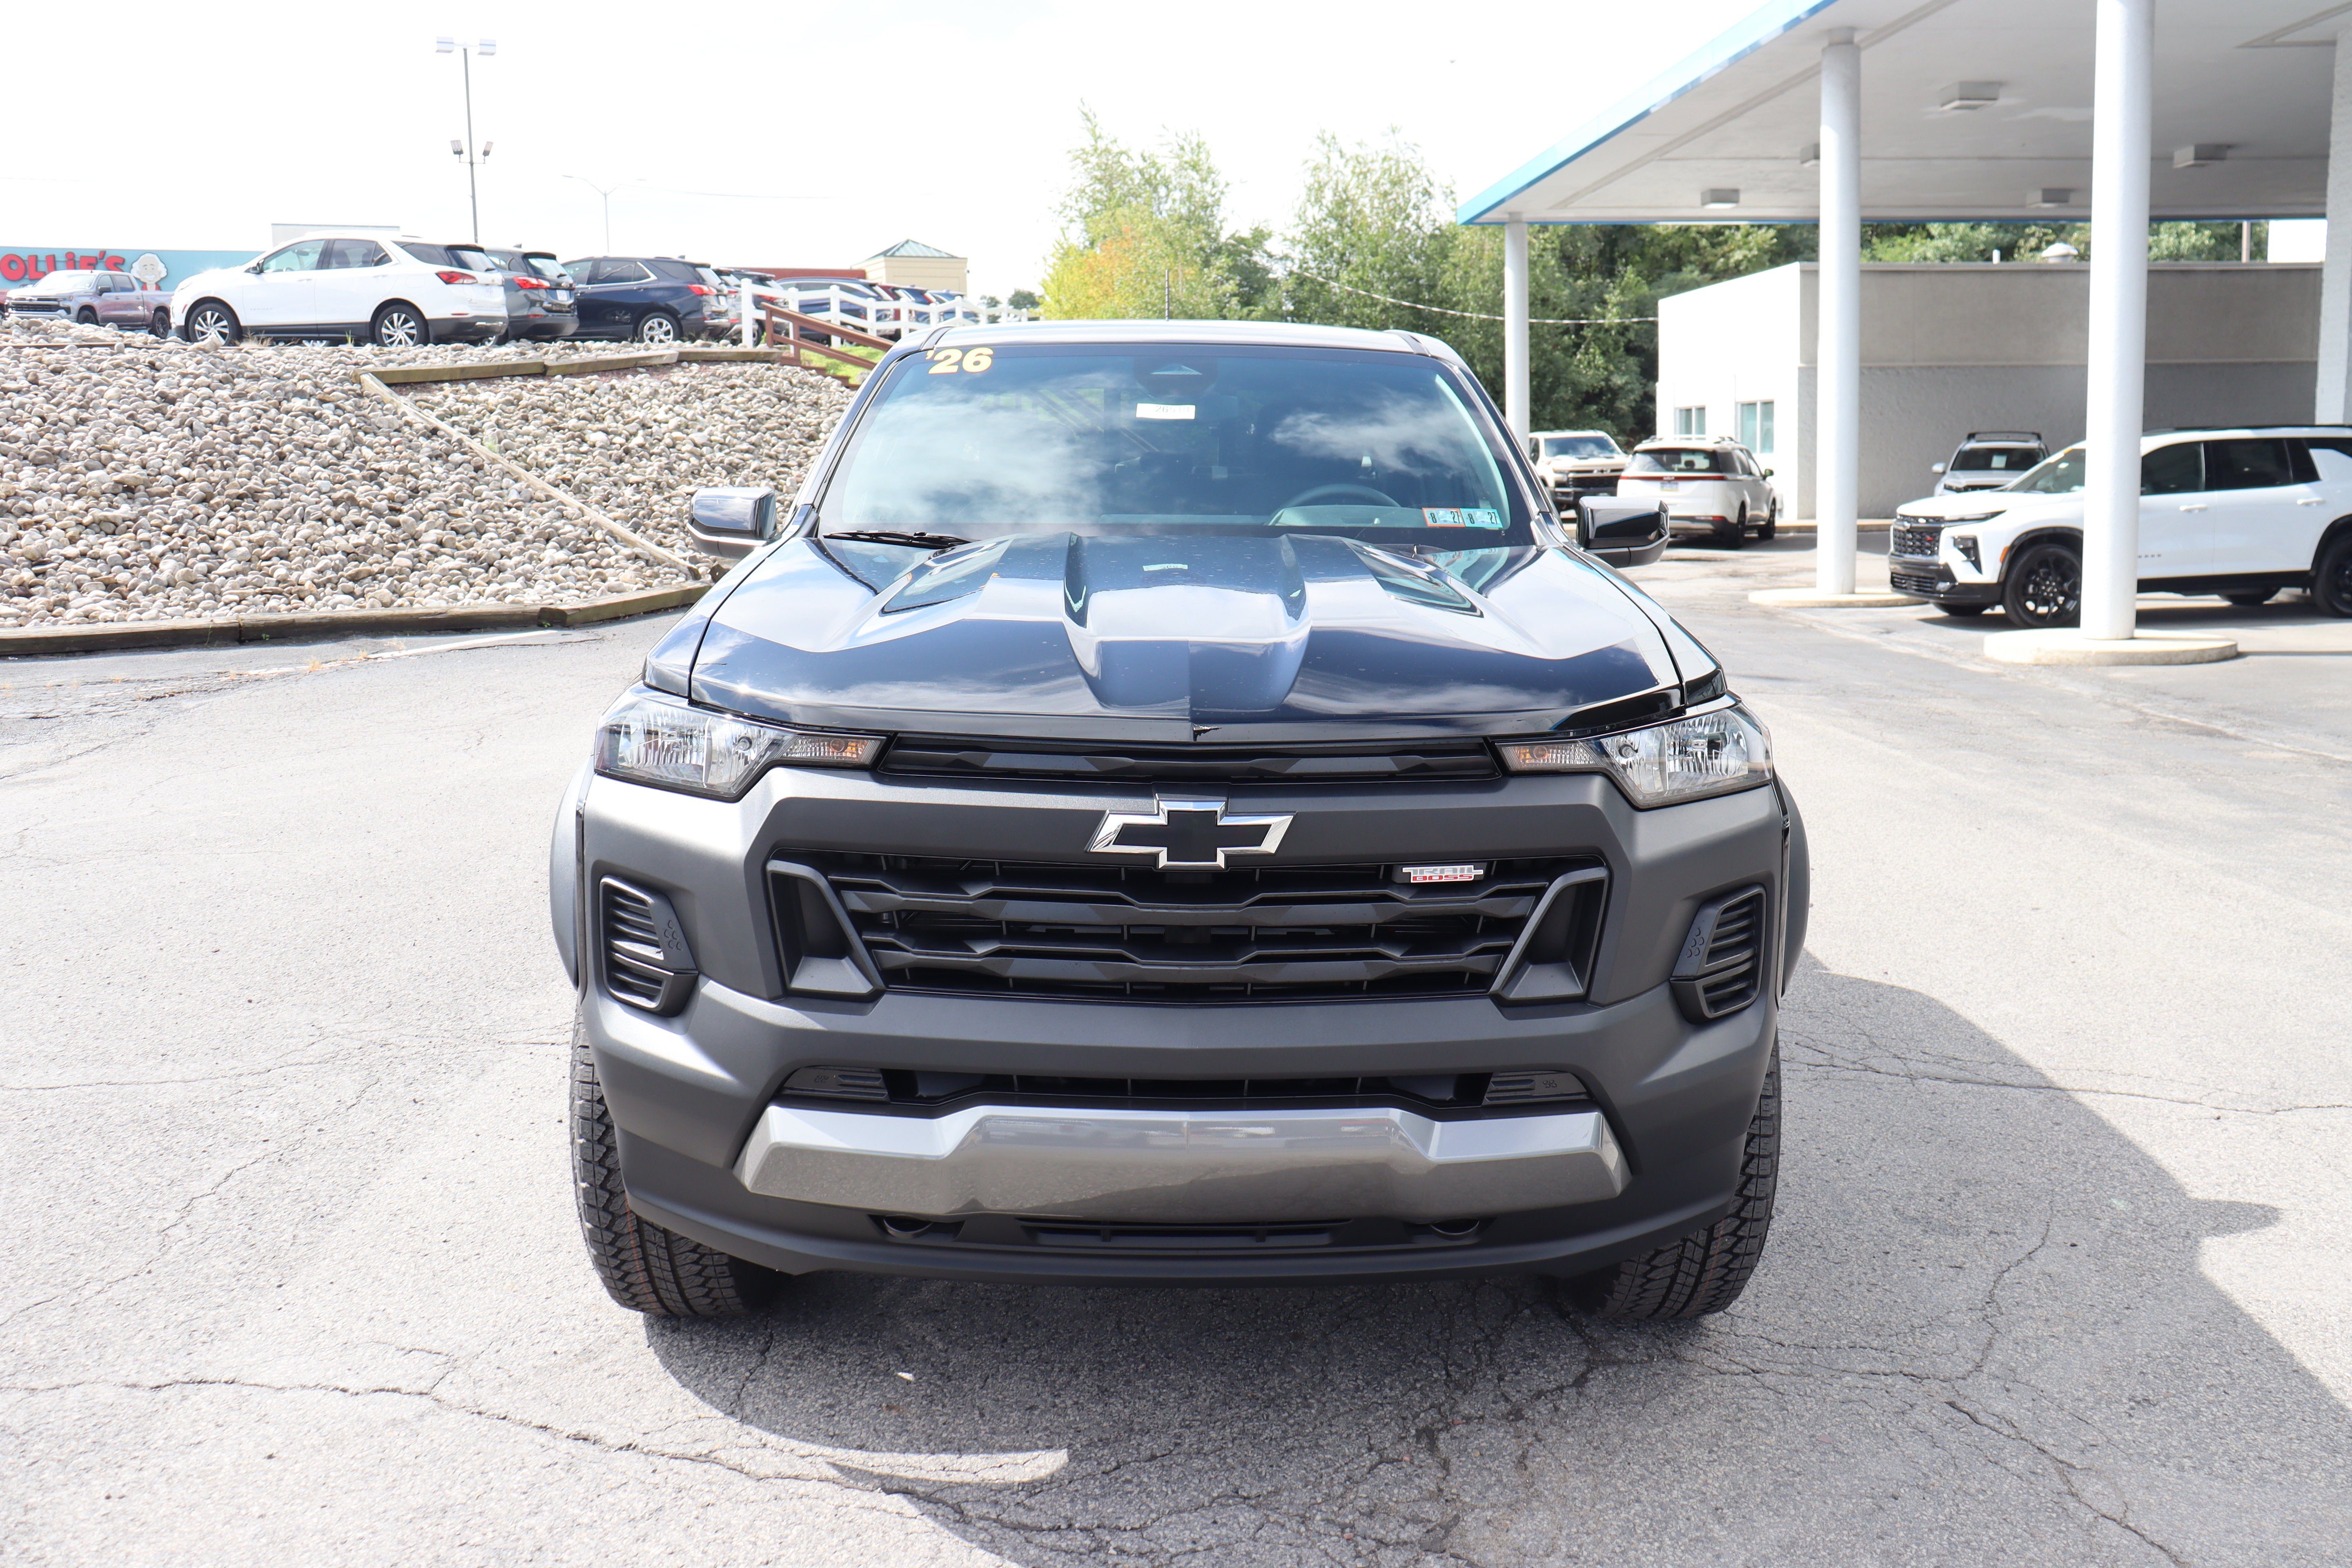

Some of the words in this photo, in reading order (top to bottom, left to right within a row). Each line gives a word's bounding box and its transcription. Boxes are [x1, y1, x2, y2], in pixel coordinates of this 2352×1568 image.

[925, 347, 994, 375] '26
[1430, 512, 1437, 523] 8
[1450, 510, 1461, 524] 27
[1468, 513, 1475, 524] 8
[1487, 511, 1498, 524] 27
[1403, 865, 1483, 875] TRAIL
